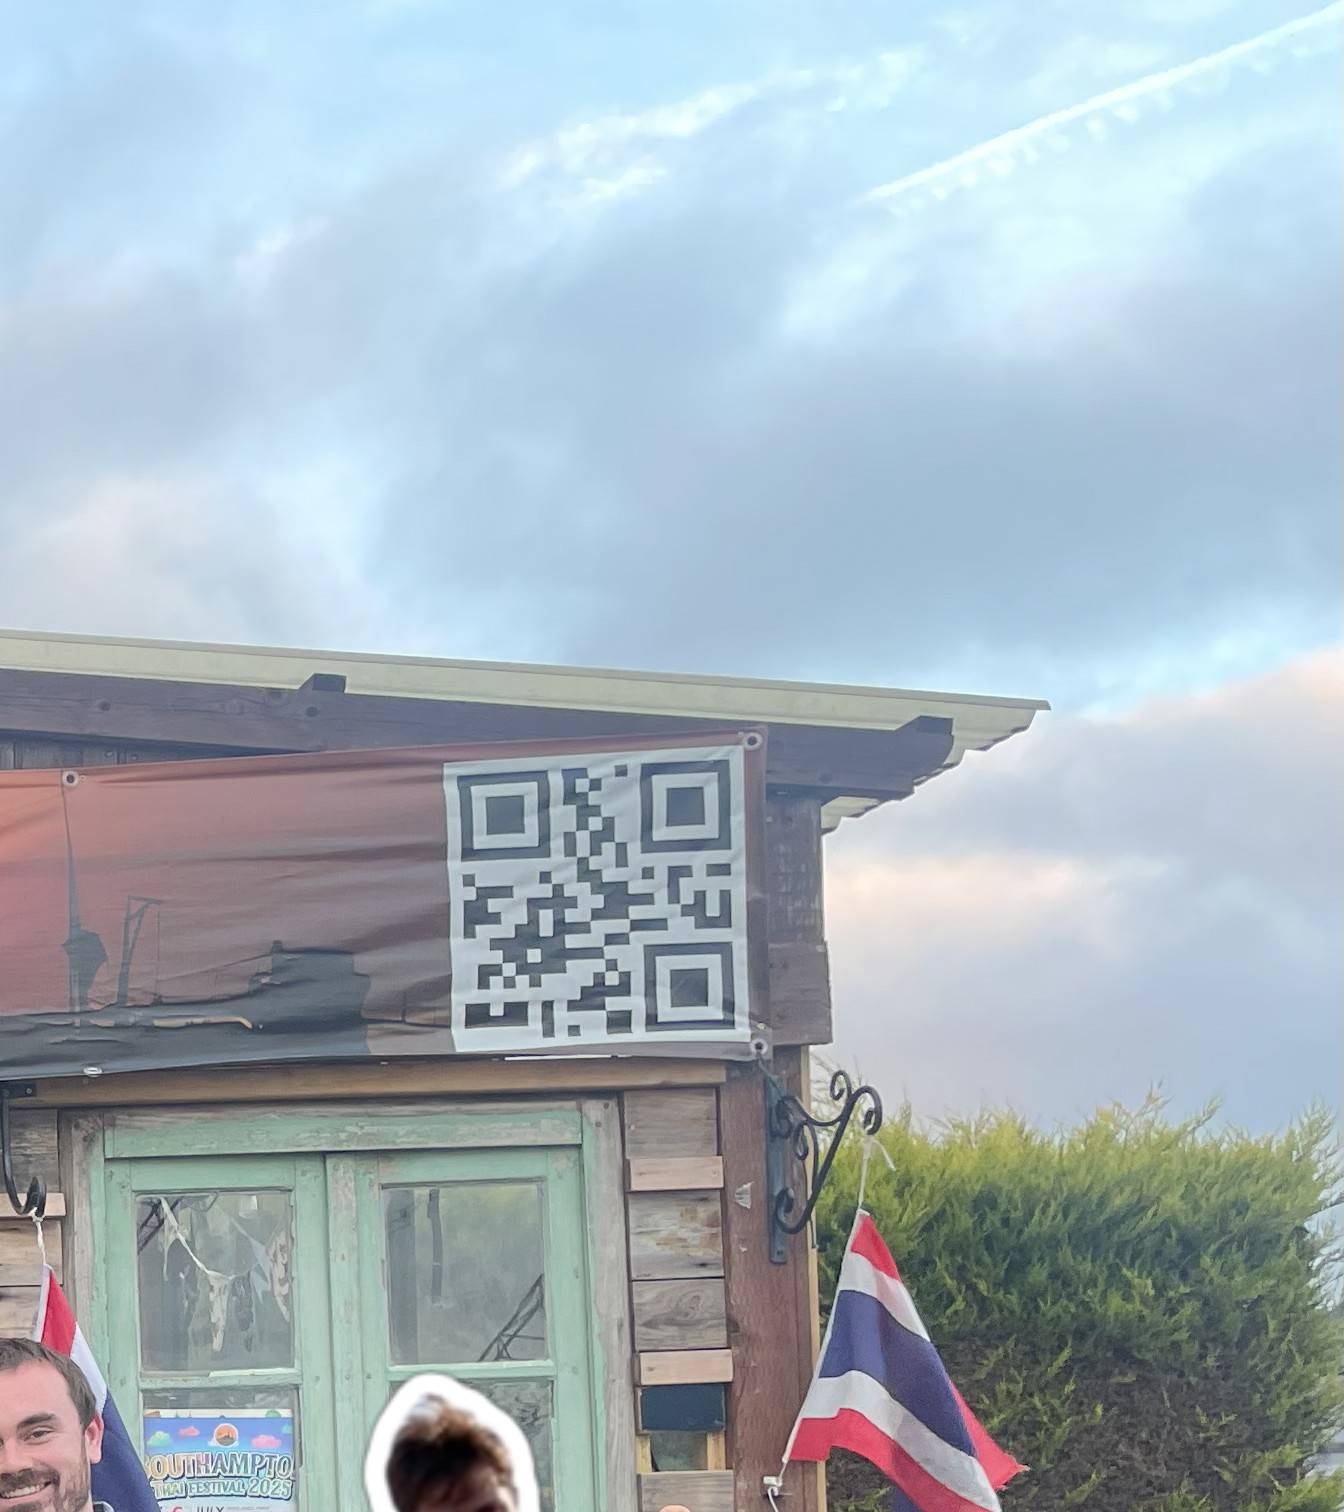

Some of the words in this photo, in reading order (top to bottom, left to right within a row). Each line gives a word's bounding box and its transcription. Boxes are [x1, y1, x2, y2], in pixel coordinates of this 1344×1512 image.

[149, 1453, 294, 1480] OUTHAMPTO
[152, 1481, 185, 1498] THAI
[188, 1480, 245, 1497] FESTIVAL
[247, 1477, 292, 1498] 2025
